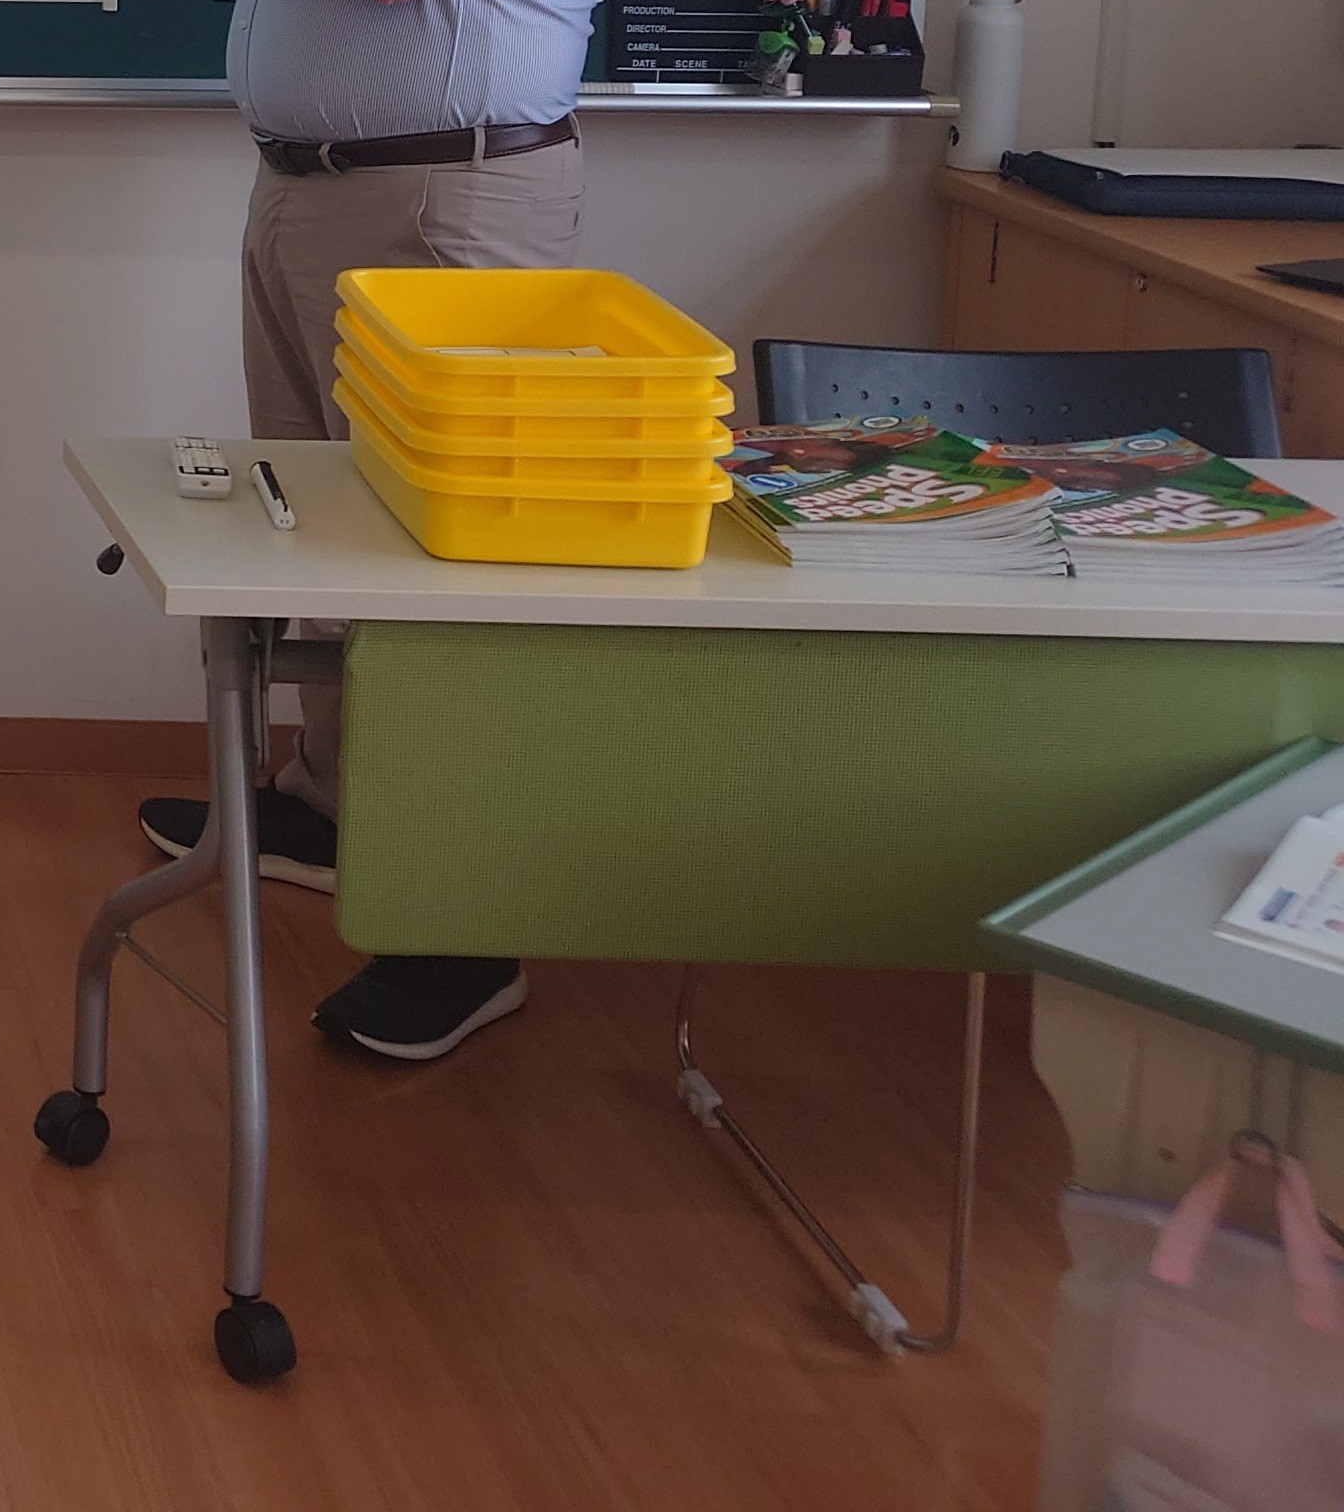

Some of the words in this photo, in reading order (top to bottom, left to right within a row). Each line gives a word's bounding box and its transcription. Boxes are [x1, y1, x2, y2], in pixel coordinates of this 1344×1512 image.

[624, 6, 675, 15] PRODUCTION
[627, 25, 667, 33] DIRECTOR
[627, 43, 660, 51] CAMERA
[675, 60, 708, 68] SCENE
[793, 478, 987, 521] Speed
[1060, 502, 1264, 535] Speed
